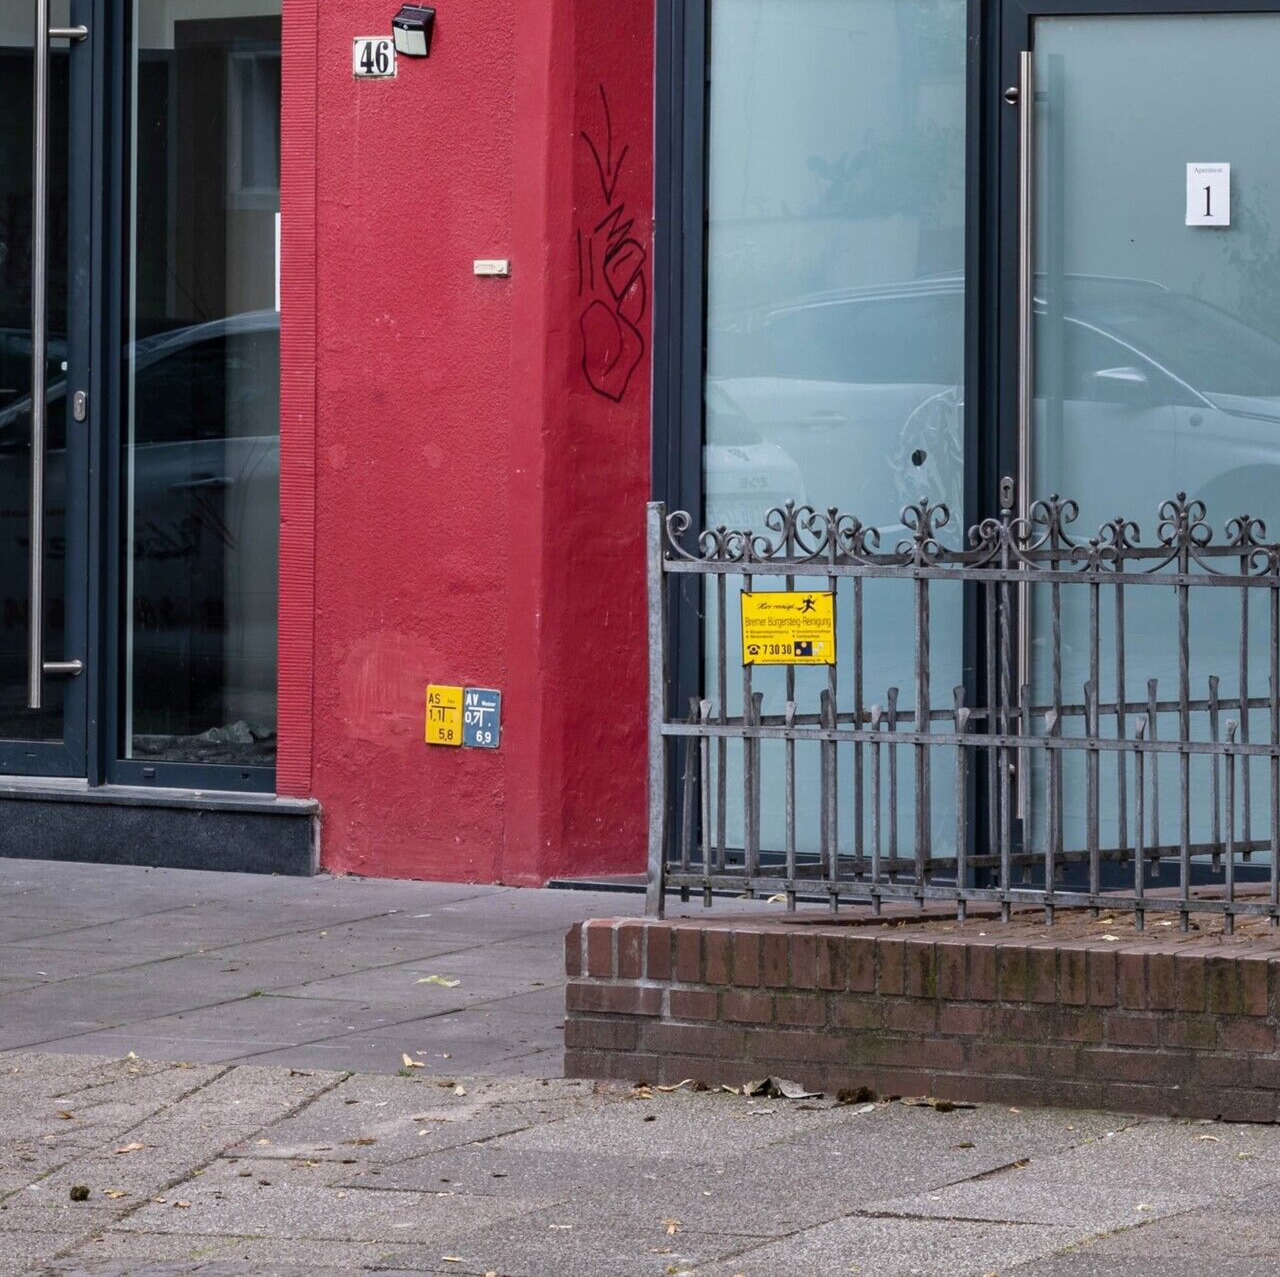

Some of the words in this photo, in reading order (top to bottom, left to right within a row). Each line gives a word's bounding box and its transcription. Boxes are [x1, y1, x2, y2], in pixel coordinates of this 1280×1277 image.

[360, 41, 389, 73] 46
[1203, 185, 1214, 217] 1
[745, 617, 766, 627] Bremer
[763, 644, 768, 654] 7
[428, 693, 441, 704] AS
[465, 694, 479, 706] AV
[464, 712, 480, 725] 0,7
[438, 728, 453, 741] 5,8
[476, 731, 492, 744] 6,9
